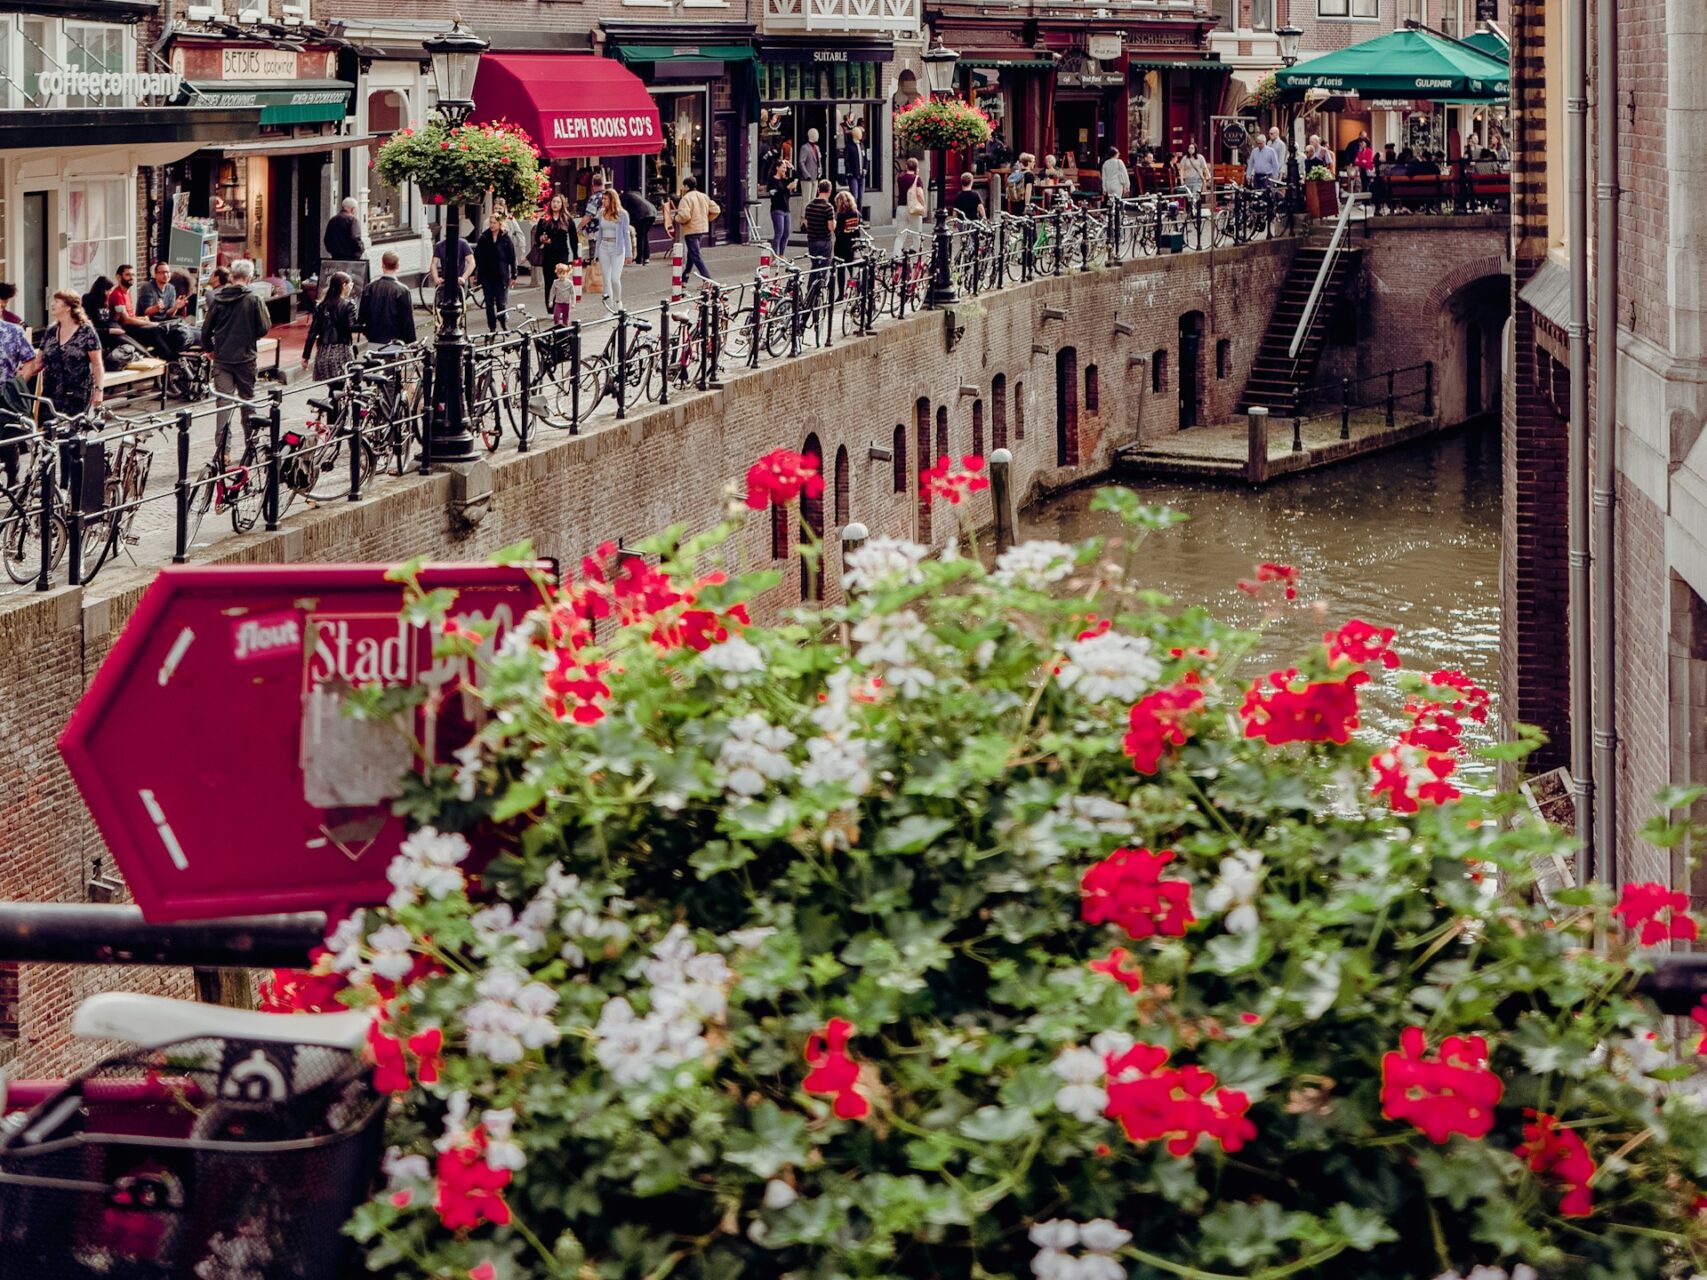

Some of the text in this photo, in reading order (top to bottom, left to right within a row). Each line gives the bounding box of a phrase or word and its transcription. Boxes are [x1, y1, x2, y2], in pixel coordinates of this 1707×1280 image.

[224, 51, 260, 73] BETSIES
[813, 51, 848, 62] SUITABLE
[37, 64, 181, 102] coffeecompany
[1415, 78, 1452, 89] GULPENER
[553, 116, 653, 139] ALEPH BOOKS CD'S
[311, 617, 408, 682] Stad
